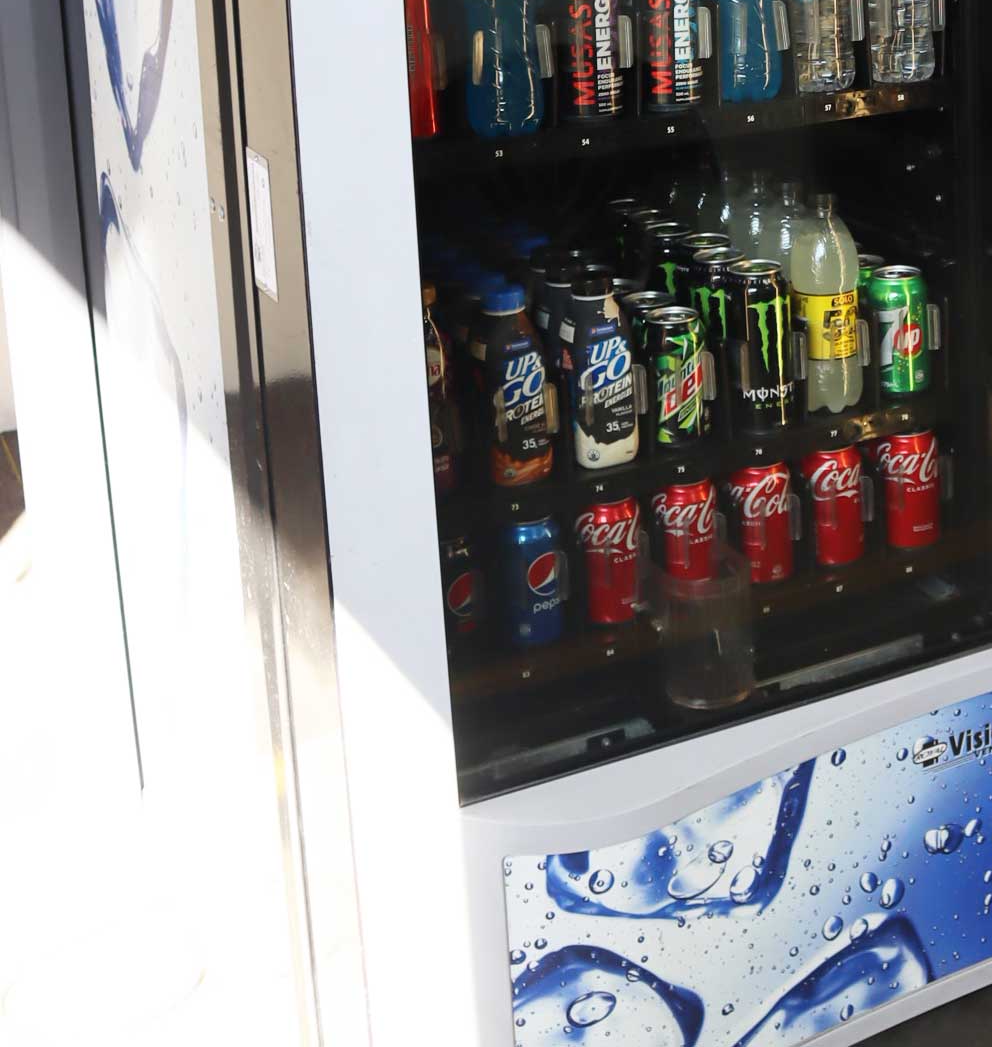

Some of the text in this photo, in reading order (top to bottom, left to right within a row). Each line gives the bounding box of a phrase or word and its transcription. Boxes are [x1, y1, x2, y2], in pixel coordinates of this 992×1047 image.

[667, 126, 675, 134] 55
[582, 138, 590, 146] 54
[496, 150, 504, 158] 53
[878, 305, 910, 366] 7
[590, 336, 628, 366] UP&
[579, 350, 632, 392] GO
[501, 366, 546, 408] GO
[610, 404, 633, 414] VANILLA
[830, 430, 838, 438] 77
[810, 460, 861, 501] Coca
